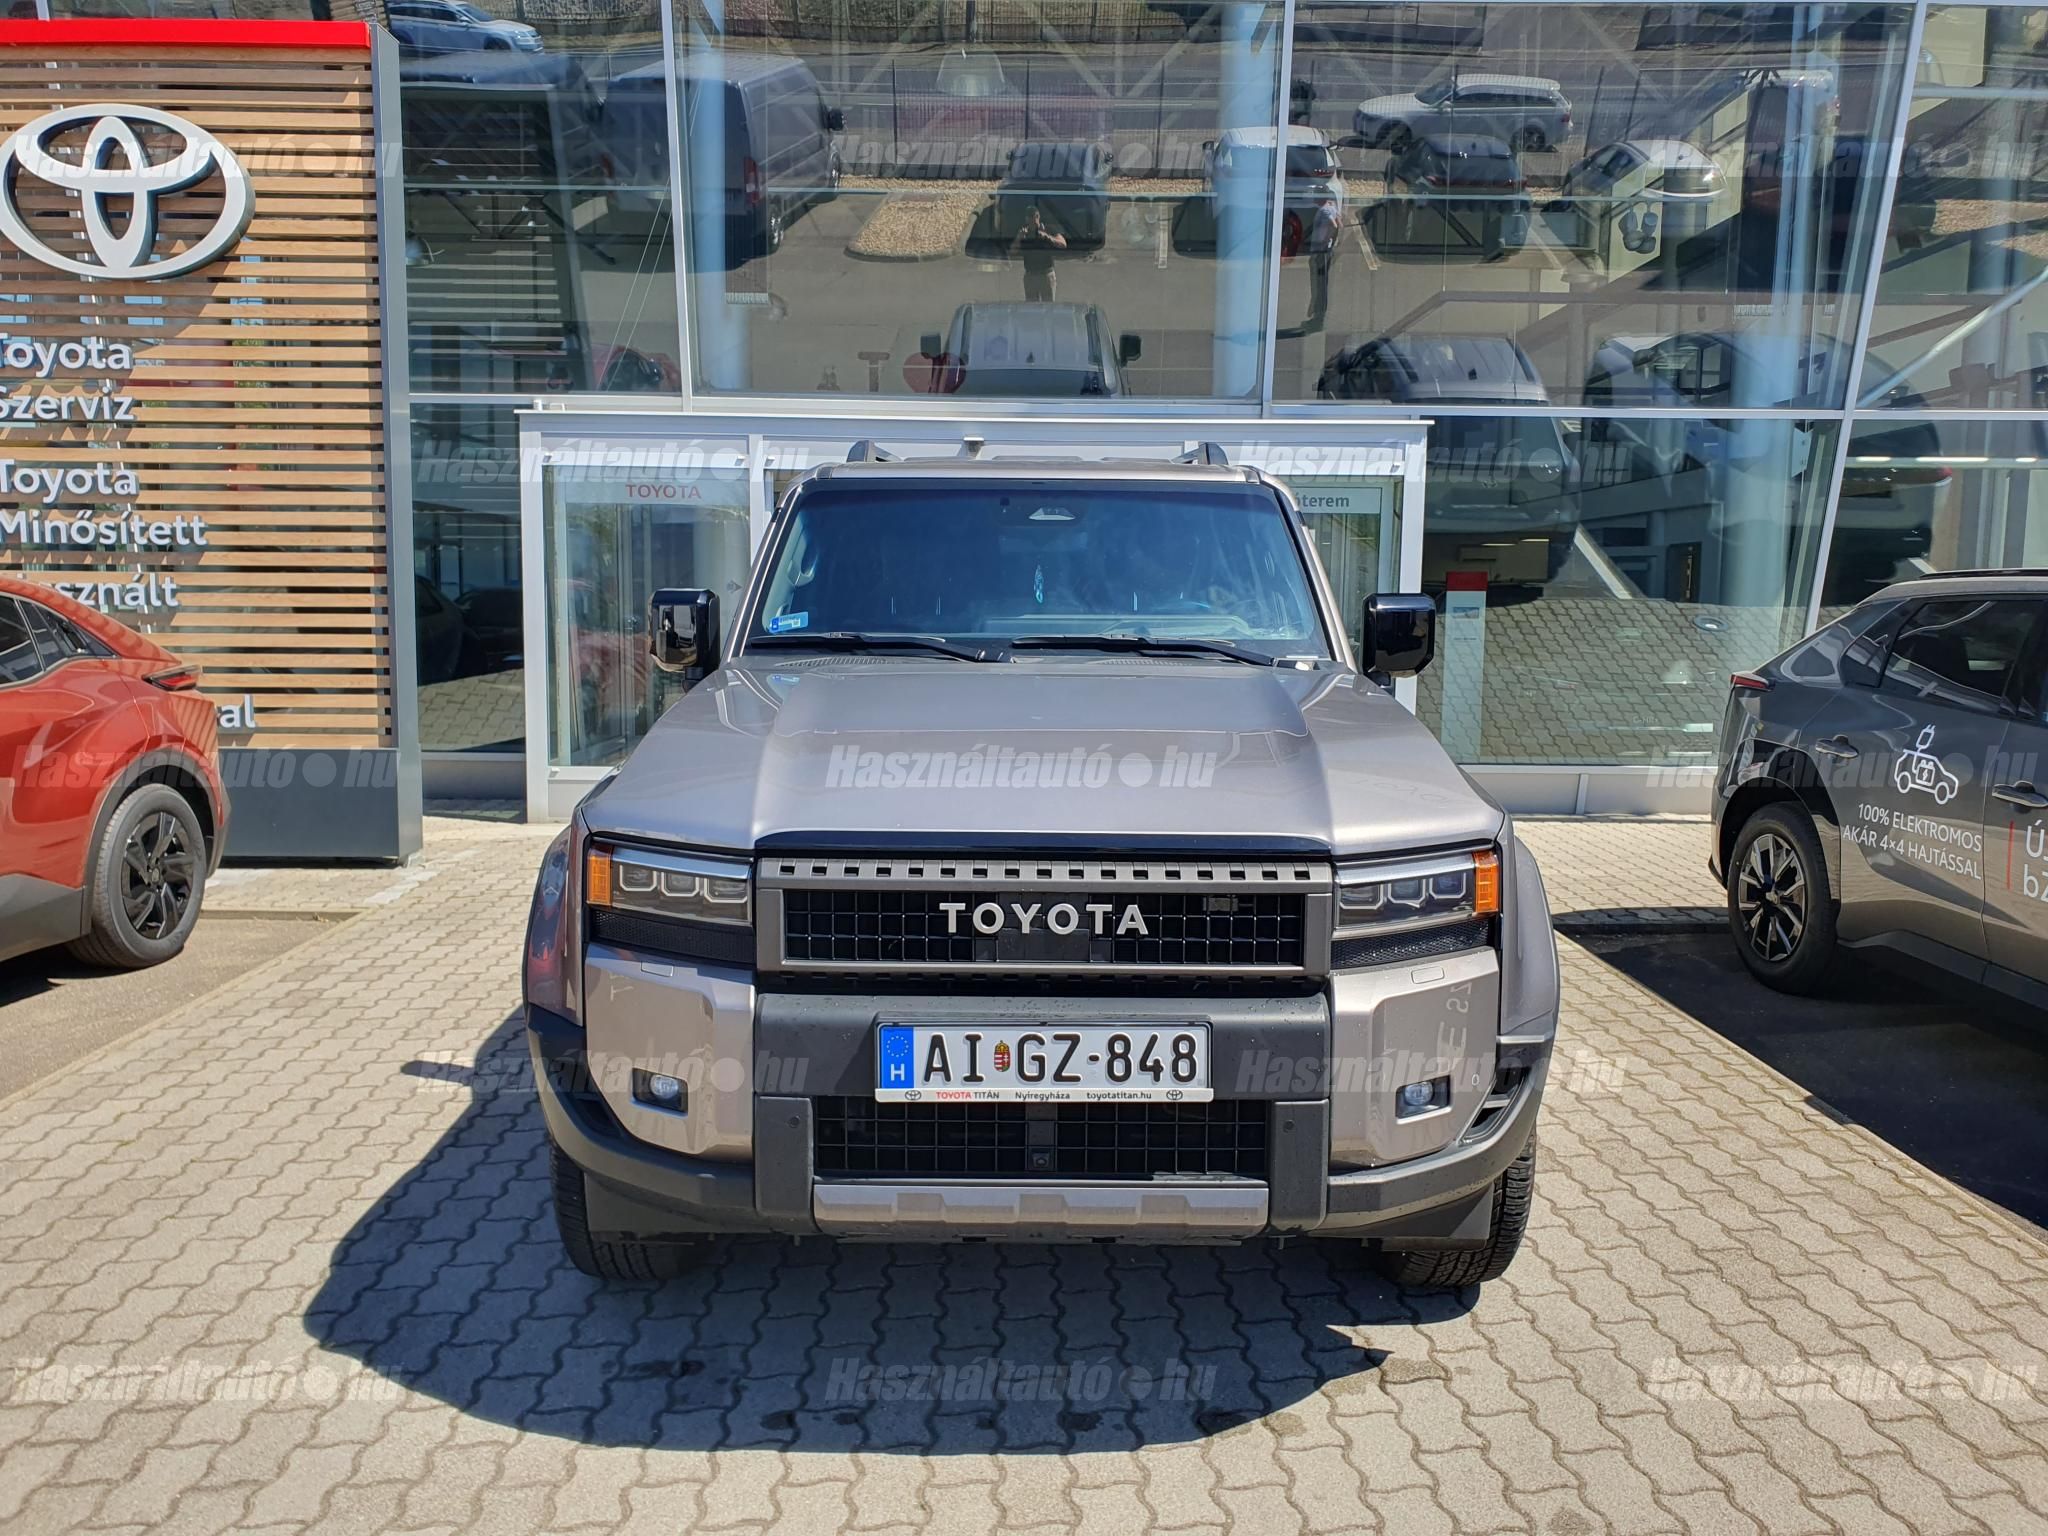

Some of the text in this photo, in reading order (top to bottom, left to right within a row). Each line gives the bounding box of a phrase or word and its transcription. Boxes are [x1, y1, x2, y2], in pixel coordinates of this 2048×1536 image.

[625, 483, 702, 499] TOYOTA
[17, 572, 180, 607] sznált
[1858, 803, 1982, 852] 100% ELEKTROMOS
[1843, 825, 1877, 848] AKÁR
[1907, 841, 1982, 880] HAJTÁSSAL
[939, 902, 1149, 935] TOYOTA
[890, 1063, 905, 1081] H
[1017, 1032, 1198, 1083] GZ-848
[936, 1089, 1152, 1101] TOYOTA TITÁN Nyíregyháza toyotatitan.hu
